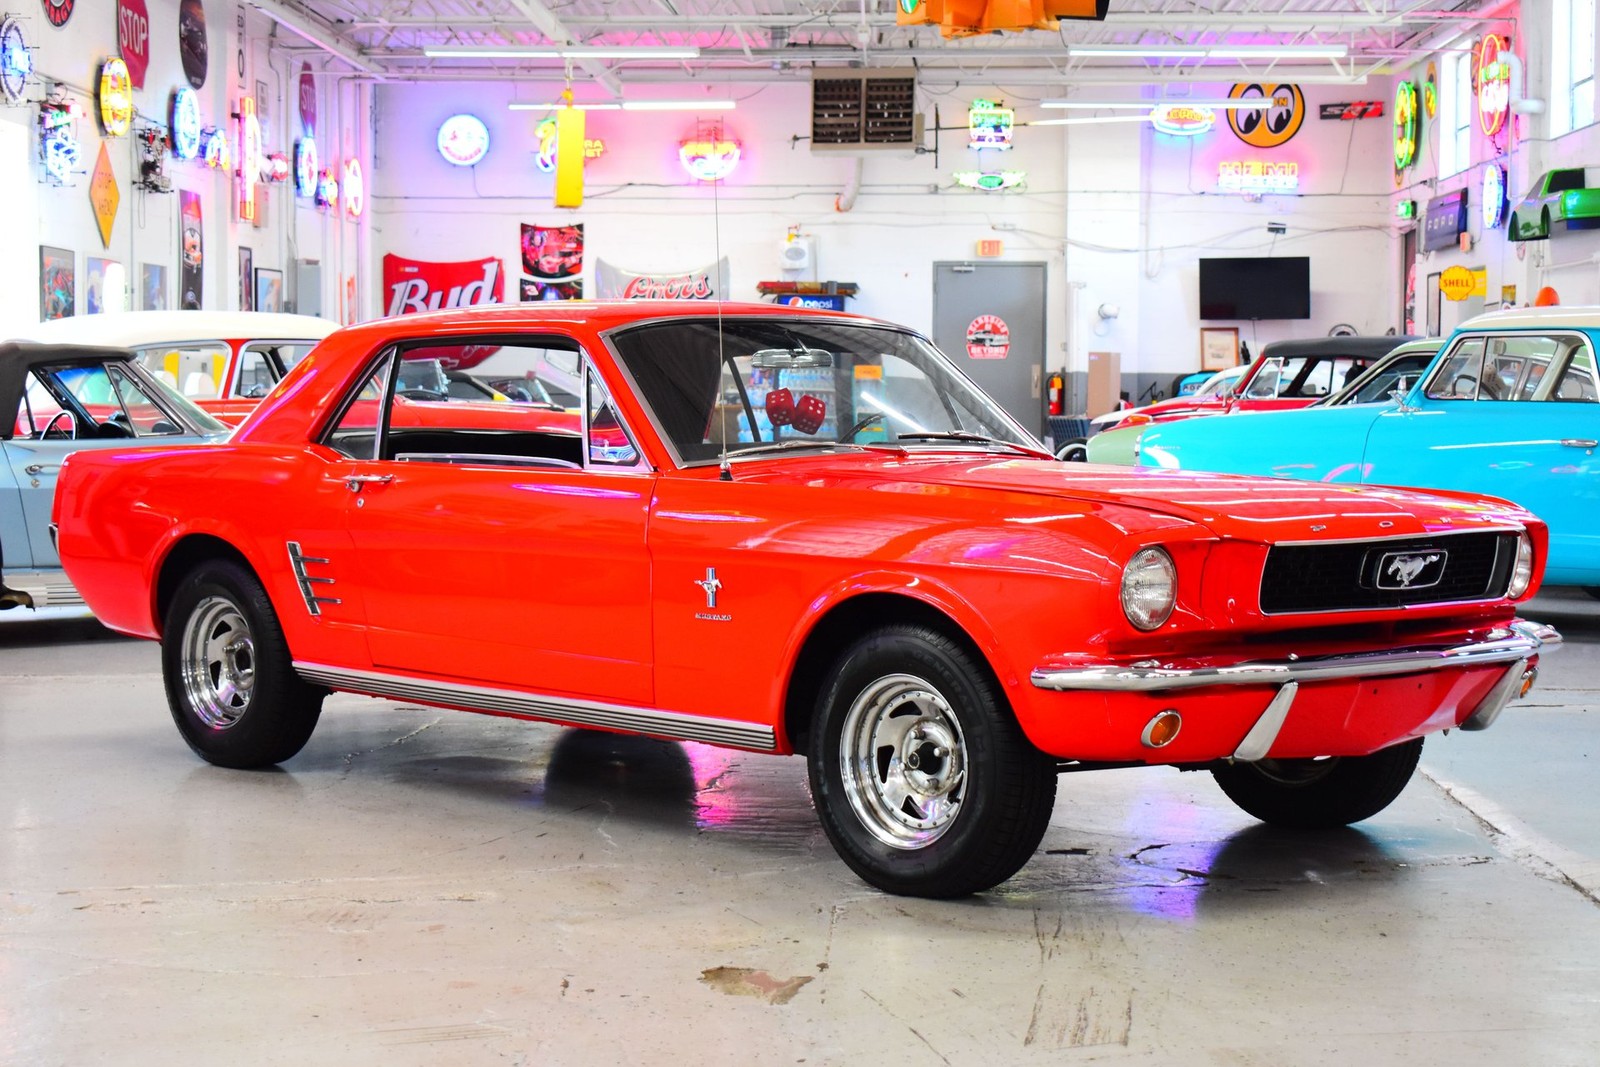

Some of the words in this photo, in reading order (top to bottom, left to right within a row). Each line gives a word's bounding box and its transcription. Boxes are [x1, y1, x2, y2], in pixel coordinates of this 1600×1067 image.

[120, 6, 147, 56] STOP
[388, 260, 500, 317] Bud
[624, 274, 714, 300] Coors
[1443, 278, 1471, 288] SHELL
[804, 300, 833, 310] pepsi
